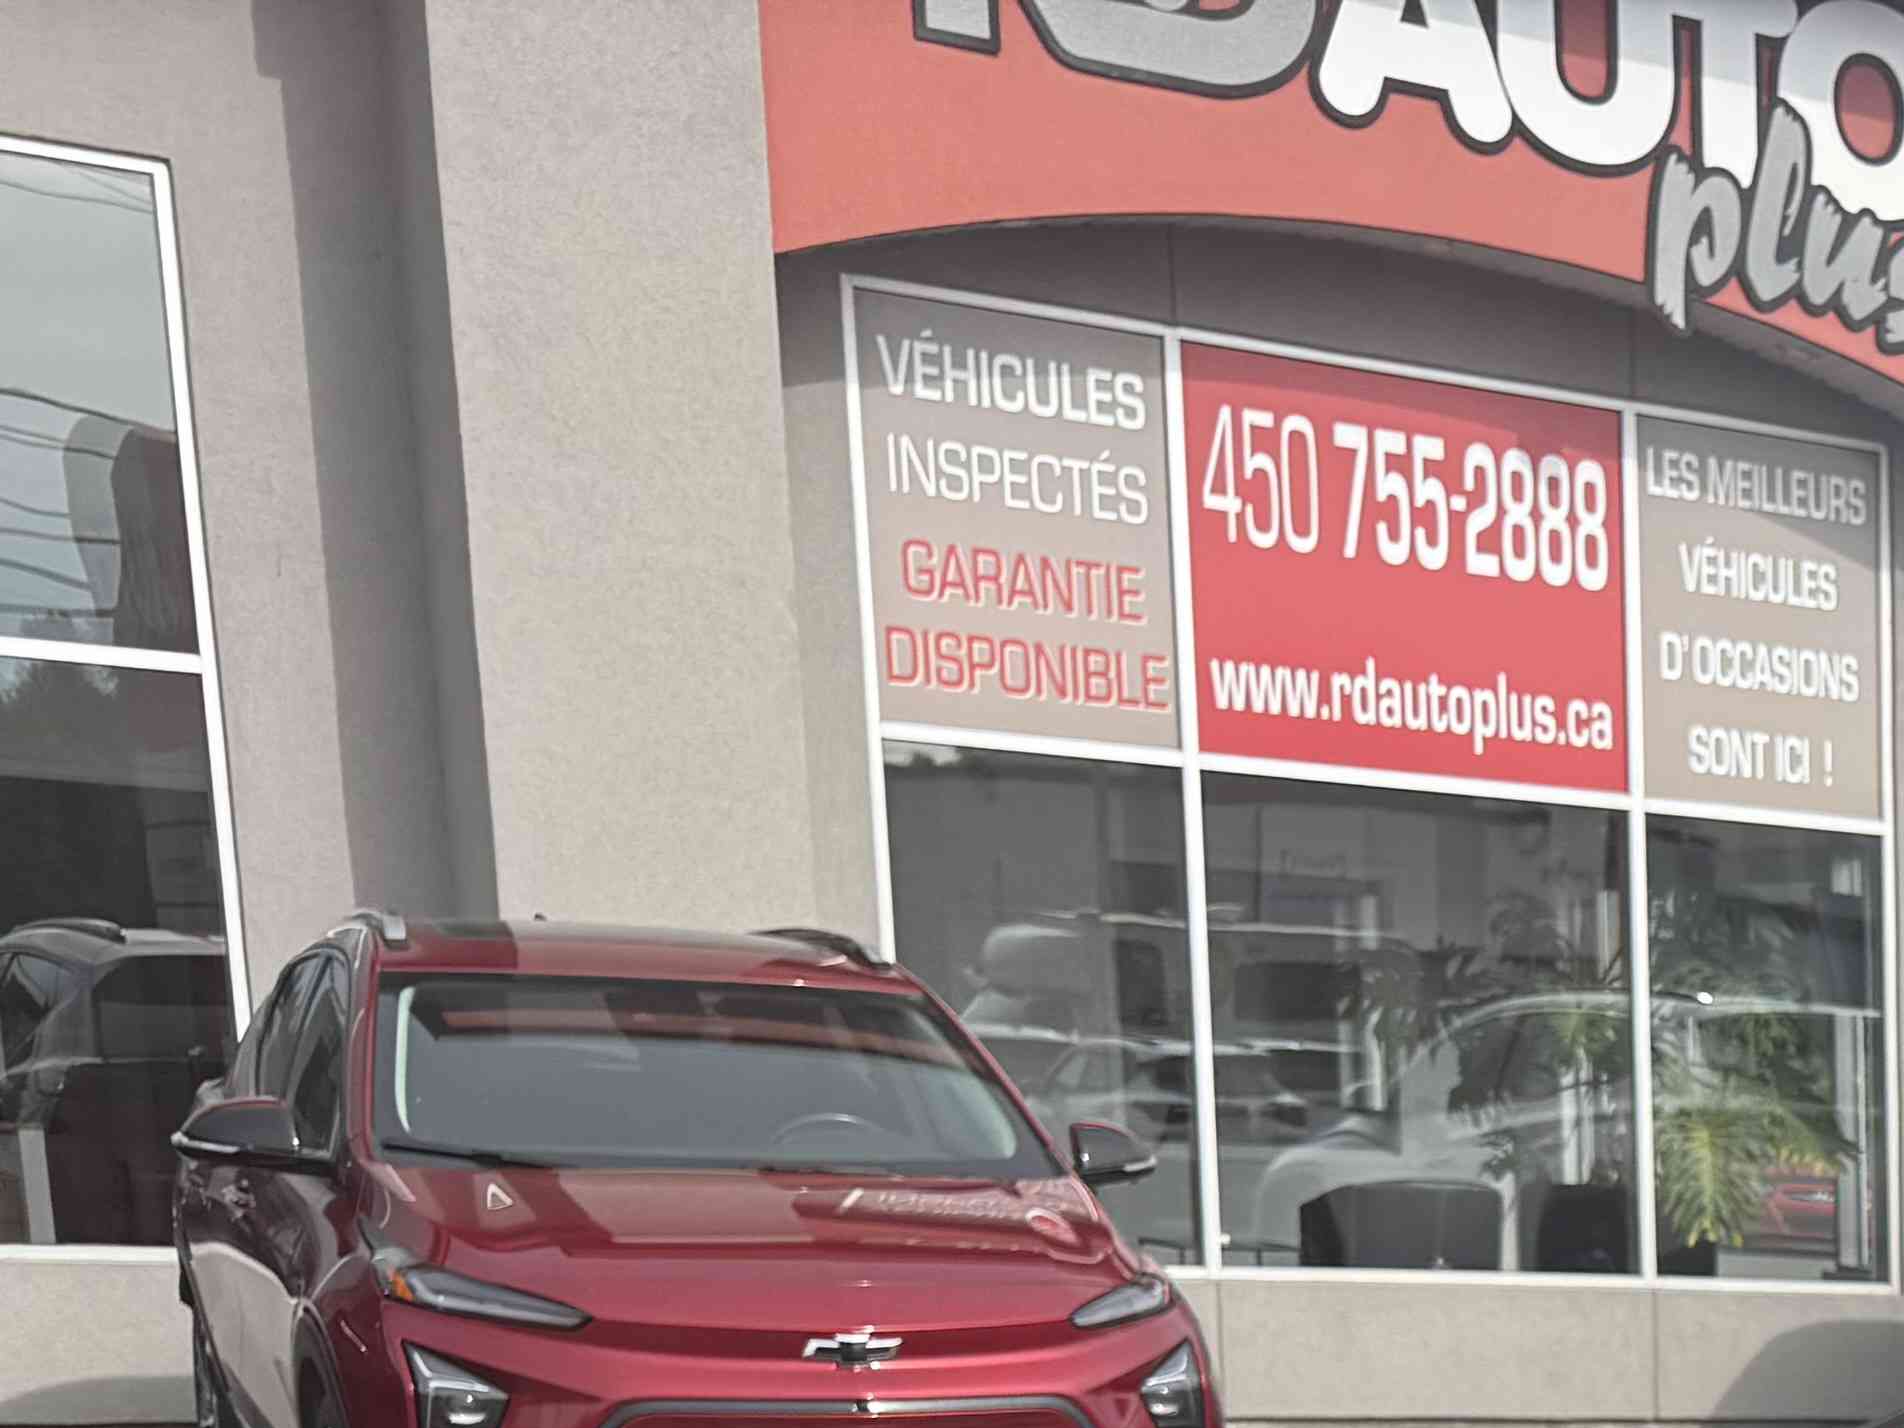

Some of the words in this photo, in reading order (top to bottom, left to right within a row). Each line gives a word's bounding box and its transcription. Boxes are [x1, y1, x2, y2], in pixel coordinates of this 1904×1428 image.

[876, 328, 1147, 431] VÉHICULES
[886, 431, 1149, 525] INSPECTÉS
[1202, 403, 1320, 554] 450
[1332, 420, 1610, 592] 755-2888
[1646, 446, 1700, 501] LES
[1706, 454, 1867, 526] MEILLEURS
[901, 537, 1149, 625] GARANTIE
[1678, 535, 1839, 612] VÉHICULES
[884, 625, 1172, 713] DISPONIBLE
[1209, 655, 1614, 756] www.rdautoplus.ca
[1687, 723, 1771, 780] SONT
[1775, 731, 1811, 785] ICI
